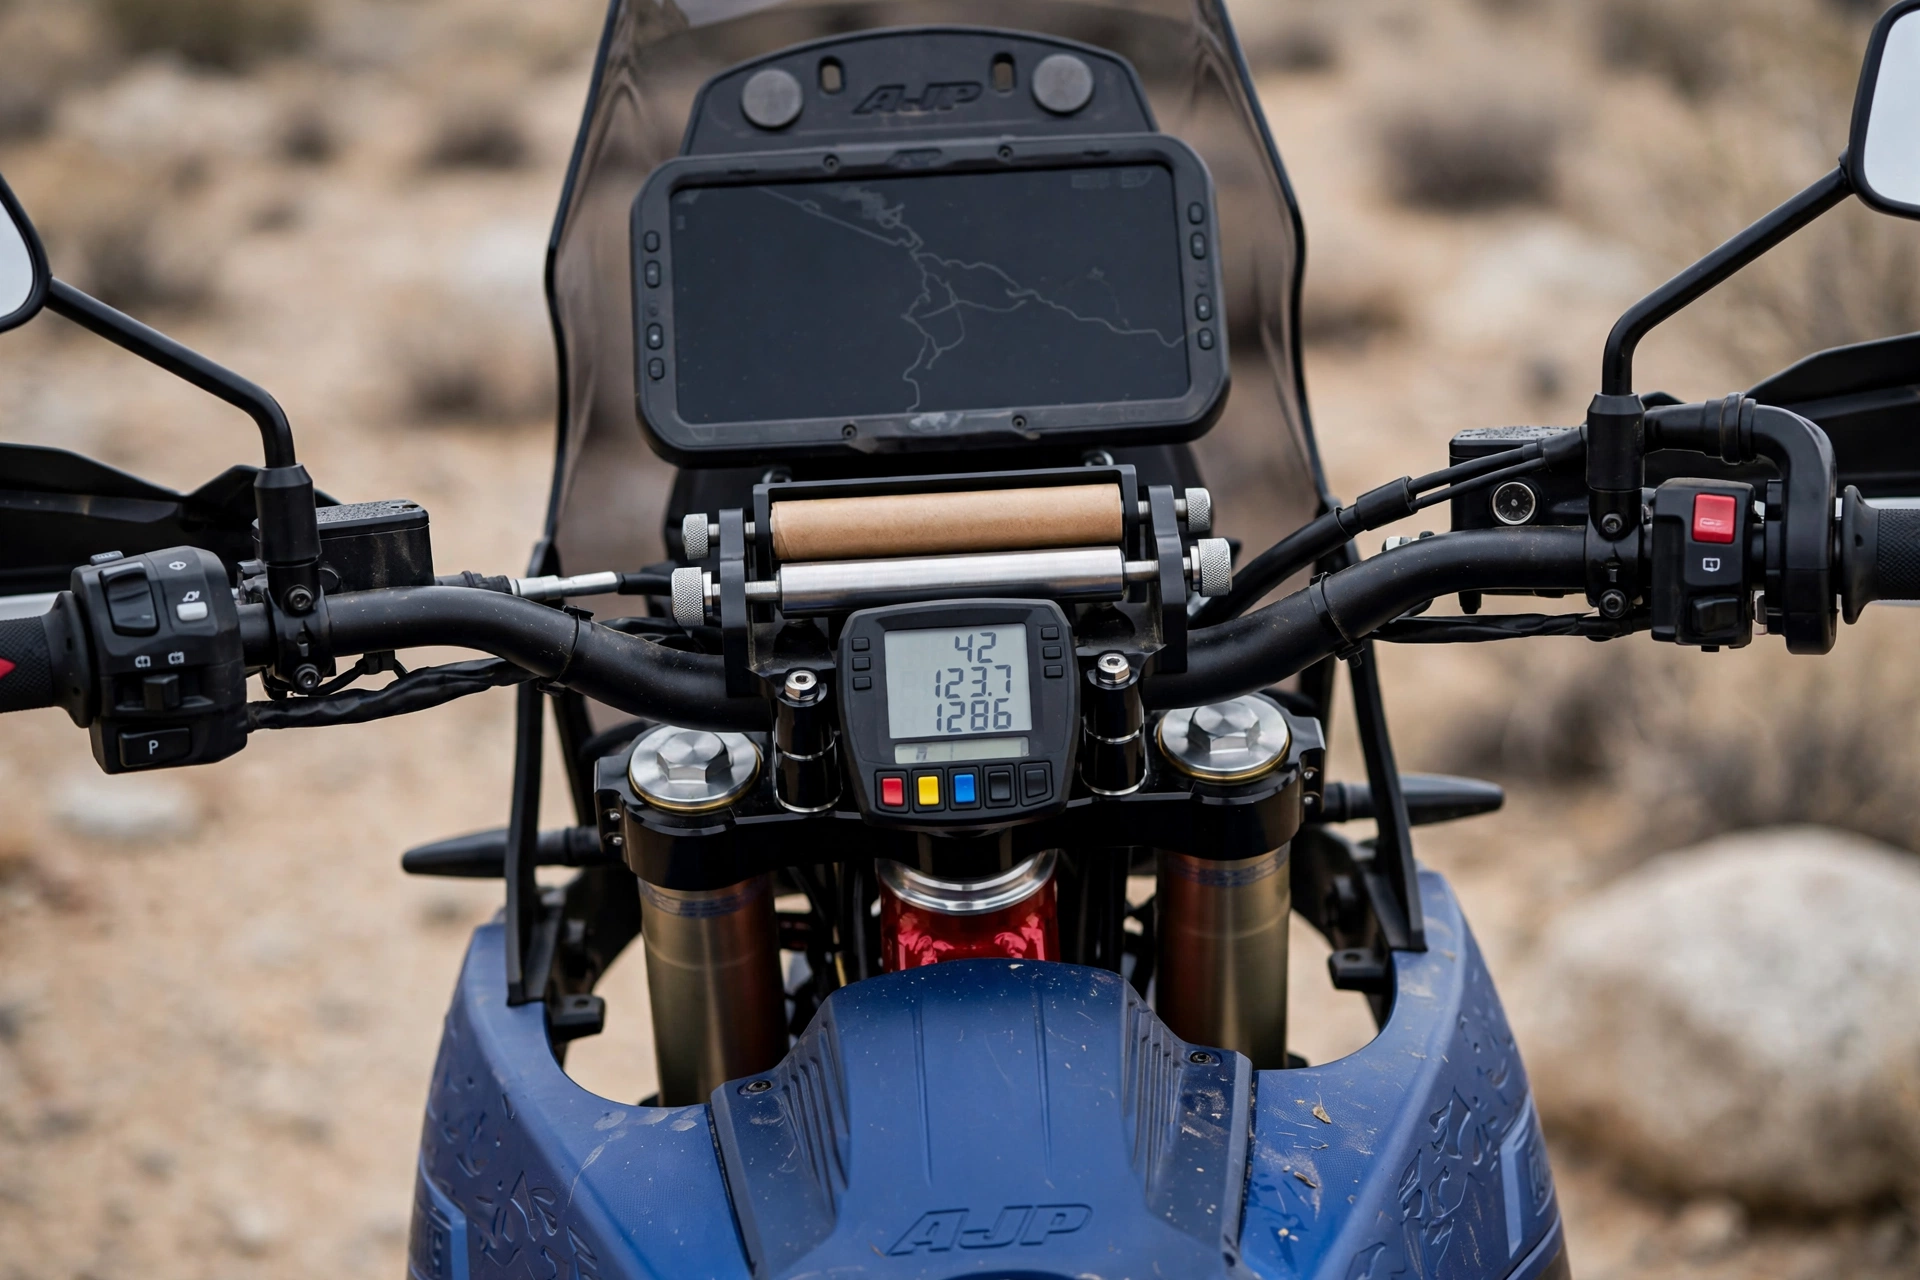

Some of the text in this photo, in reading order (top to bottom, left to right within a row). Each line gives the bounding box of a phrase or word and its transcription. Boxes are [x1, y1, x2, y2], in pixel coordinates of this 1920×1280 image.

[852, 81, 984, 115] AJP
[954, 632, 997, 664] 42
[935, 664, 1012, 699] 123.7
[936, 697, 1012, 733] 1286
[148, 739, 159, 755] P
[886, 1203, 1094, 1257] AJP
